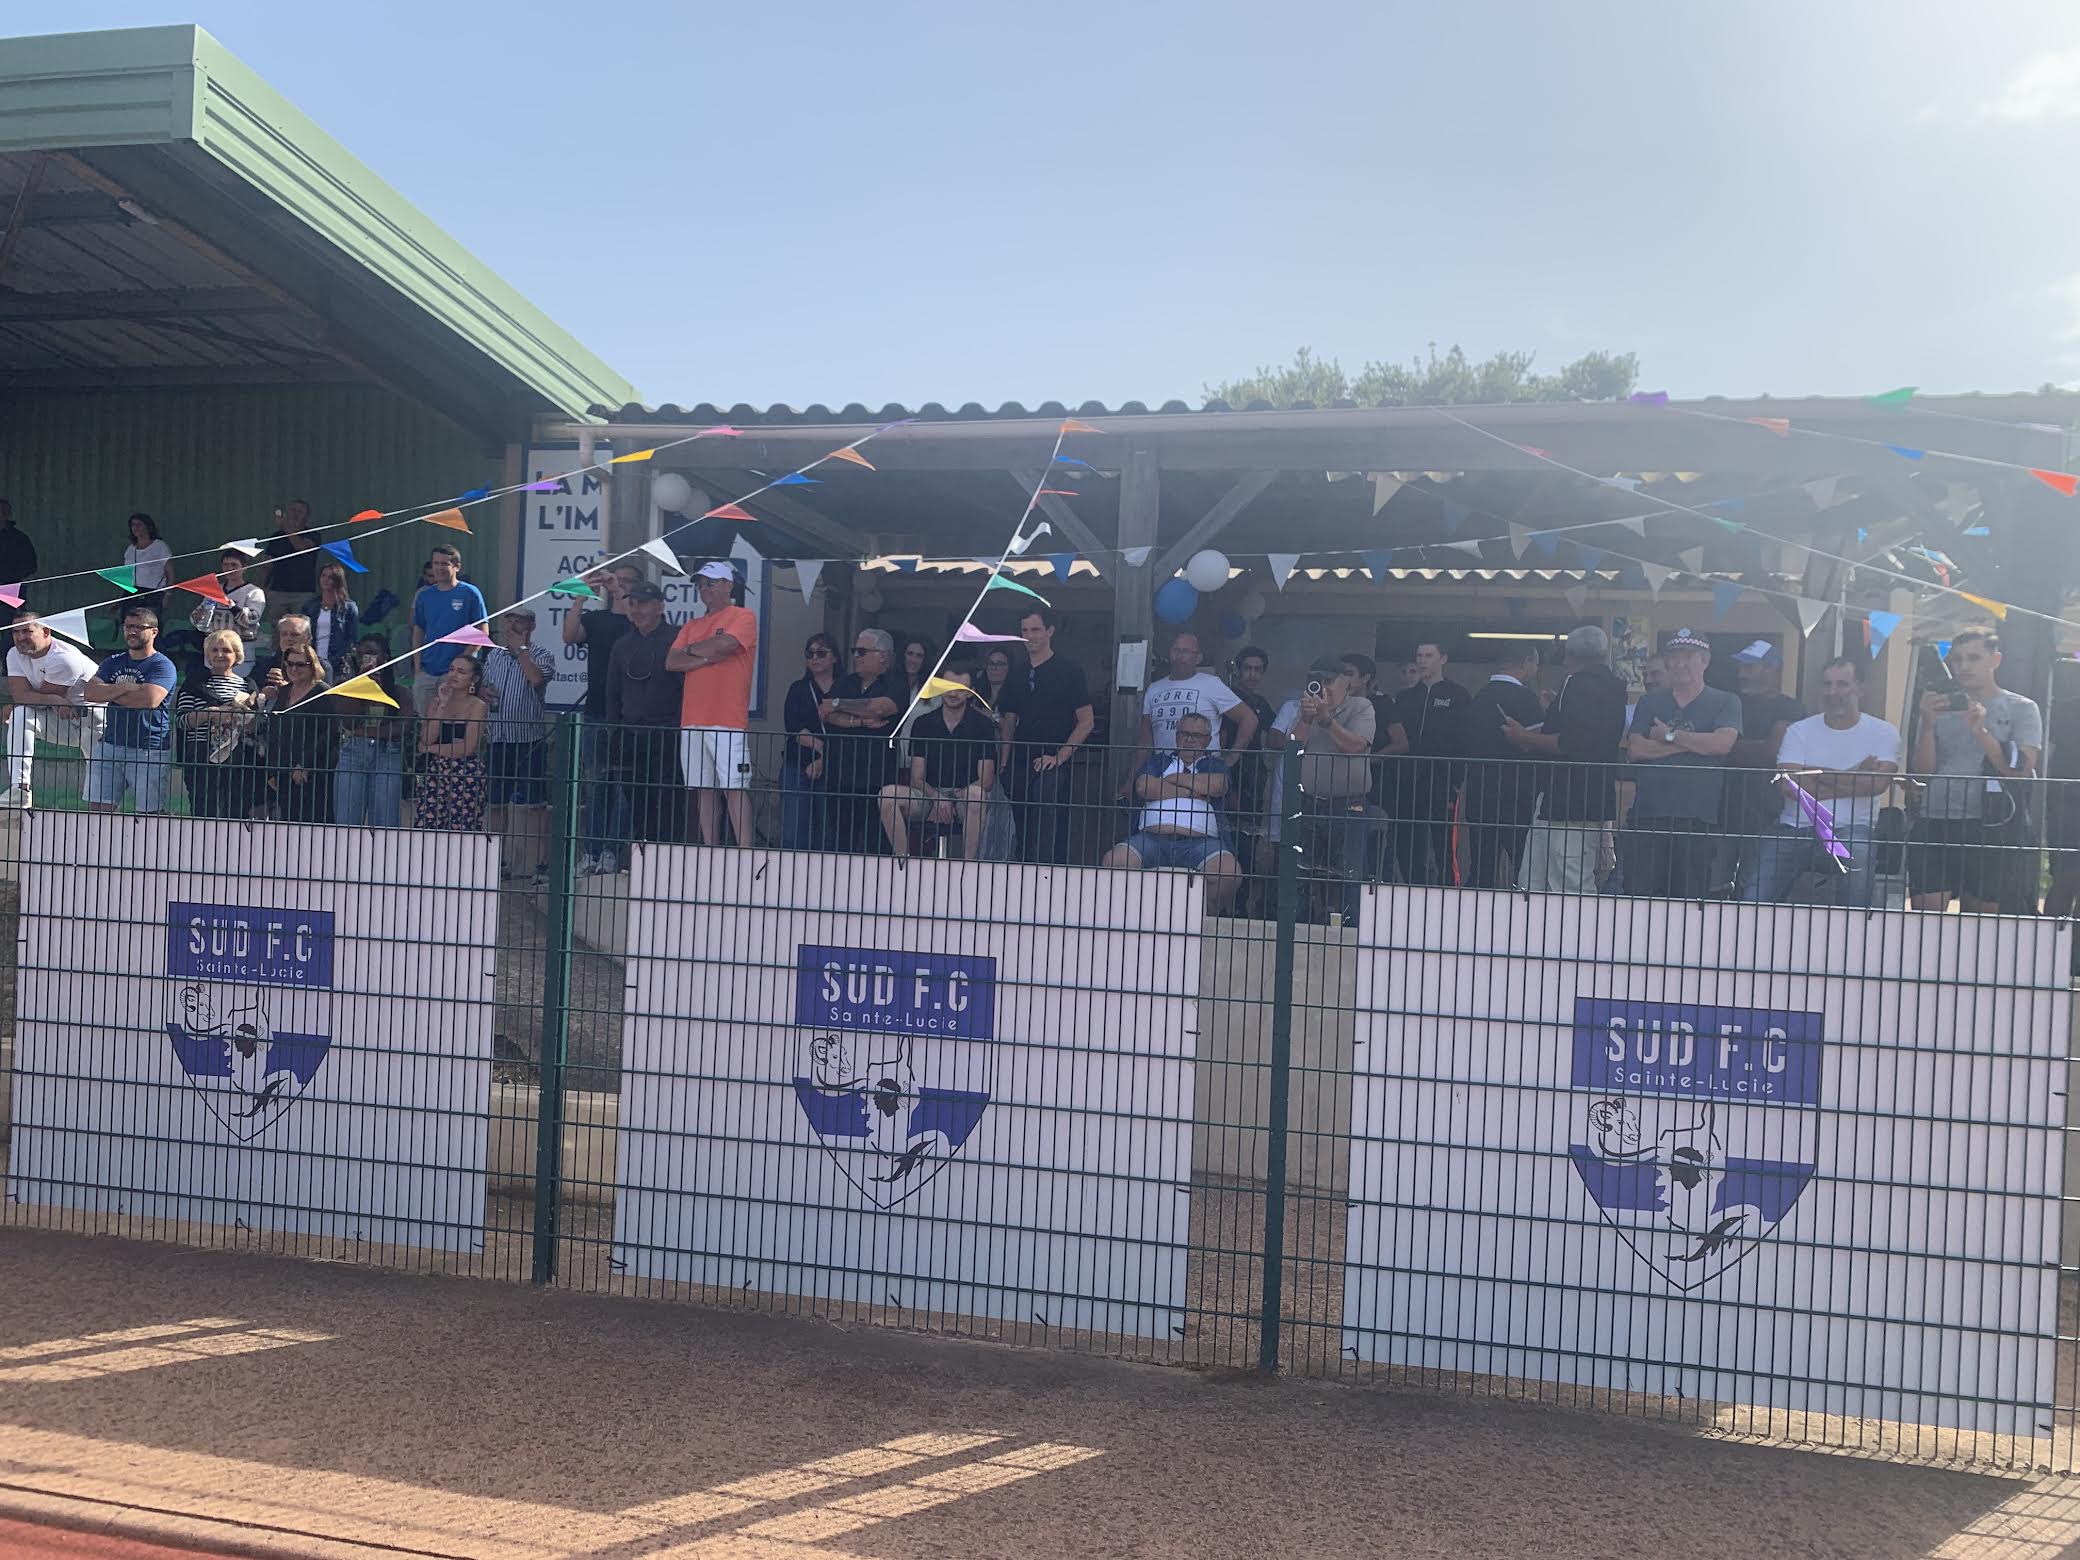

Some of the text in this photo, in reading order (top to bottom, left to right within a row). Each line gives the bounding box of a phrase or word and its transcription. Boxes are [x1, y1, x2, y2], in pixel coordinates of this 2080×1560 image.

[189, 917, 313, 963] SUD F.C
[822, 961, 968, 1012] SUD F.C
[830, 1007, 958, 1031] Sante-Lucie
[1605, 1016, 1787, 1074] SUD F.C
